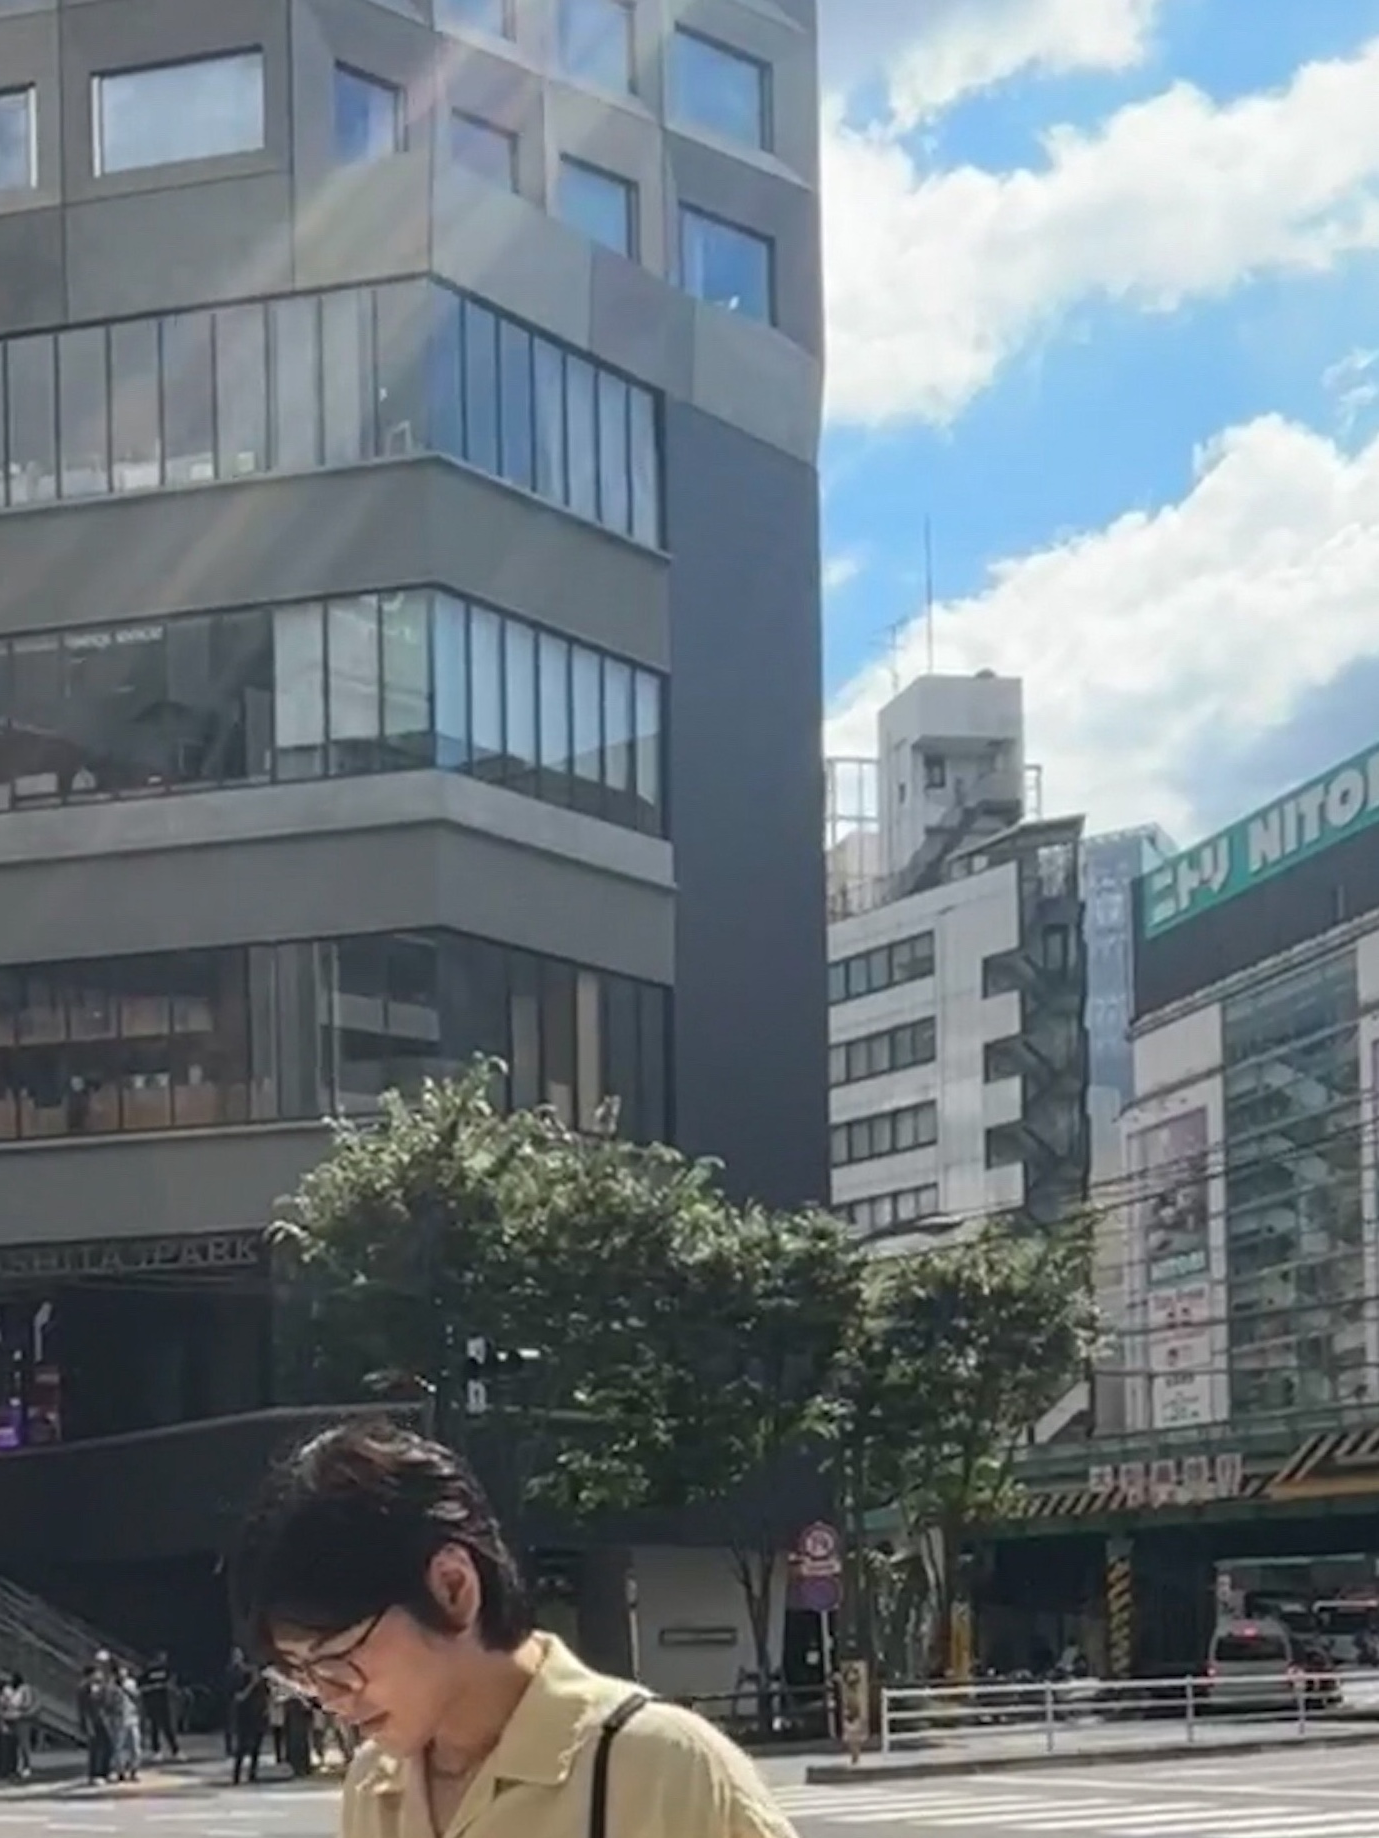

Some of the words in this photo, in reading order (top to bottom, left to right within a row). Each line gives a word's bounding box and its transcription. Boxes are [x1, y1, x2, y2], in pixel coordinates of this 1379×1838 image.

[1152, 836, 1230, 923] ニトリ
[153, 1237, 259, 1268] PARK
